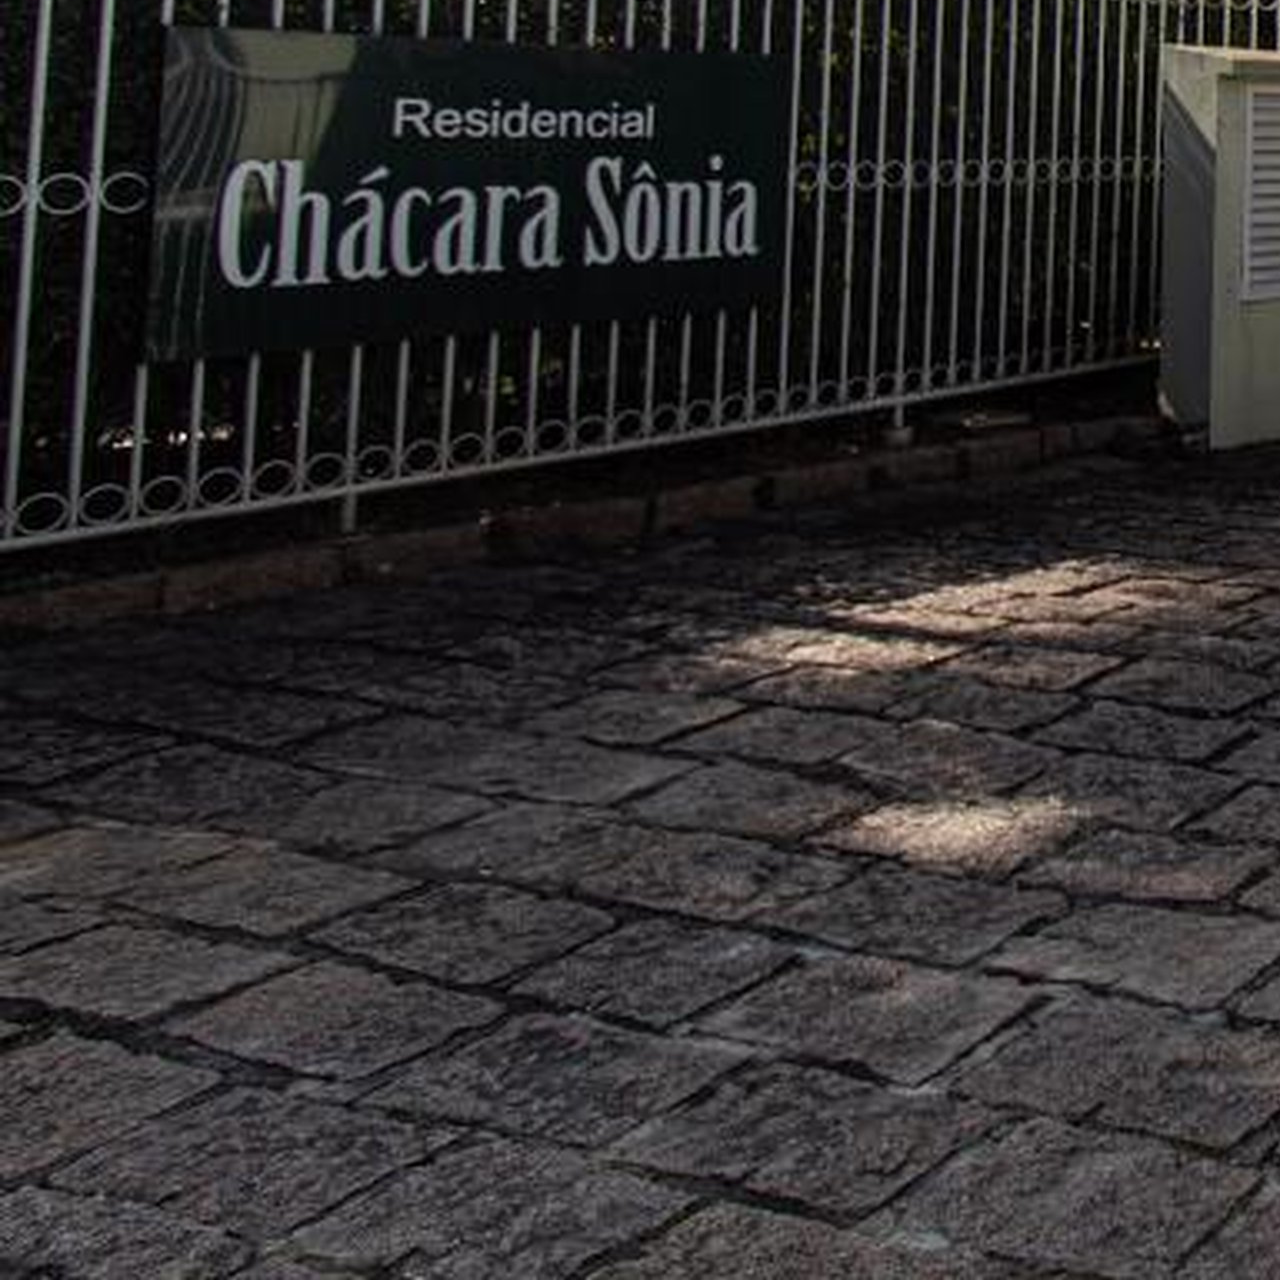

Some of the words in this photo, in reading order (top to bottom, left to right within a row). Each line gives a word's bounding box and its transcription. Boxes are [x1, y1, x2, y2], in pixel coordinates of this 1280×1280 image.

[393, 98, 654, 139] Residencial
[219, 158, 562, 289] Chácara
[585, 155, 760, 266] Sônia
